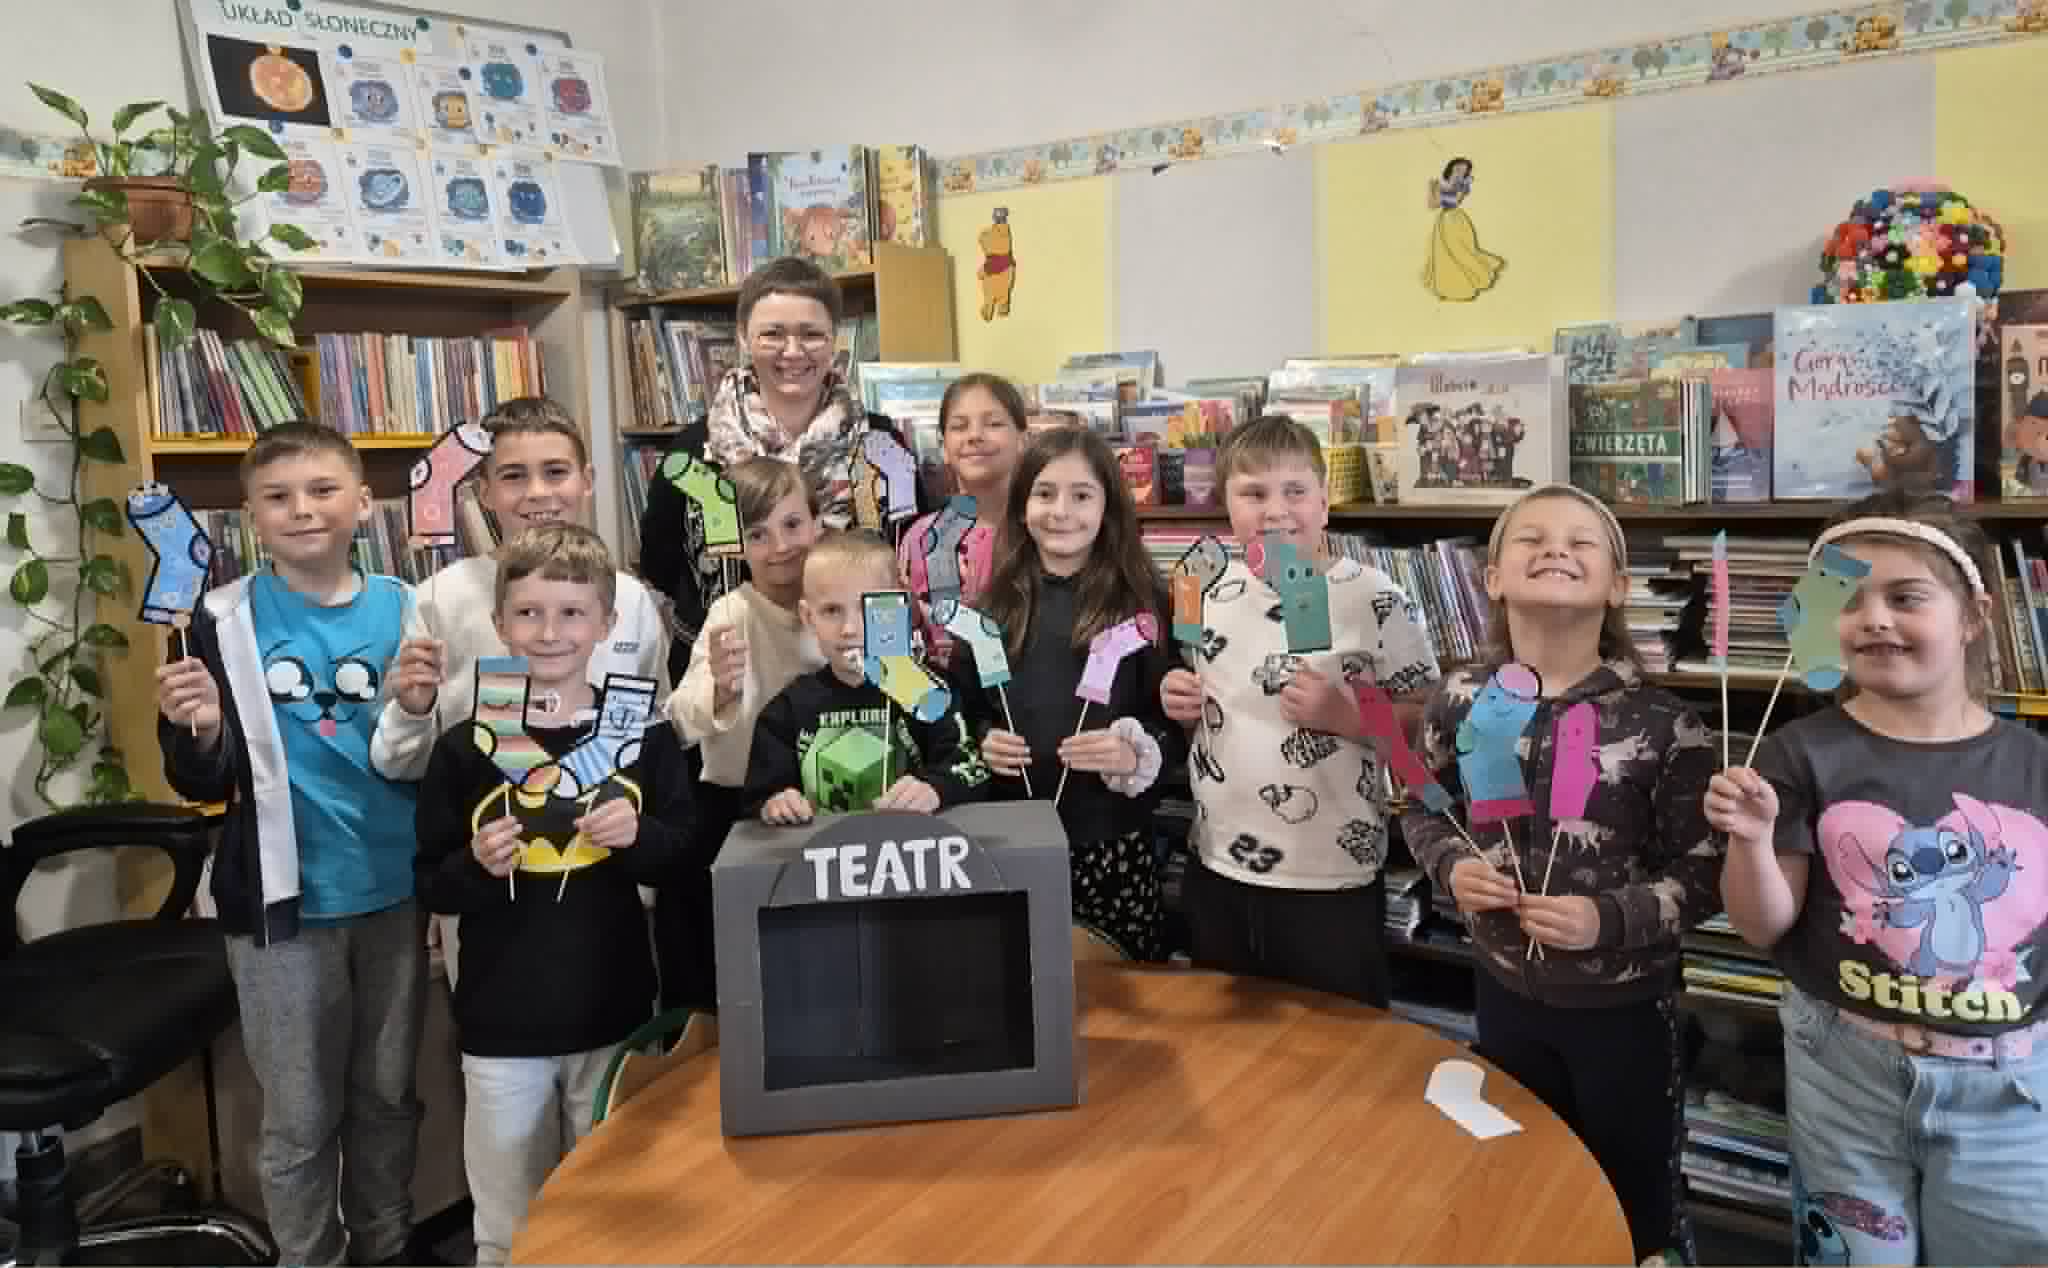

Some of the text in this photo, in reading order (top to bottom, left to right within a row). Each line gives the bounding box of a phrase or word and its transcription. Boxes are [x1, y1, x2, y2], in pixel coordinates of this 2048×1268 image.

[221, 3, 417, 41] UKŁAD SŁONECZNY
[1574, 433, 1668, 455] ZWIERZĘTA
[803, 836, 972, 901] TEATR
